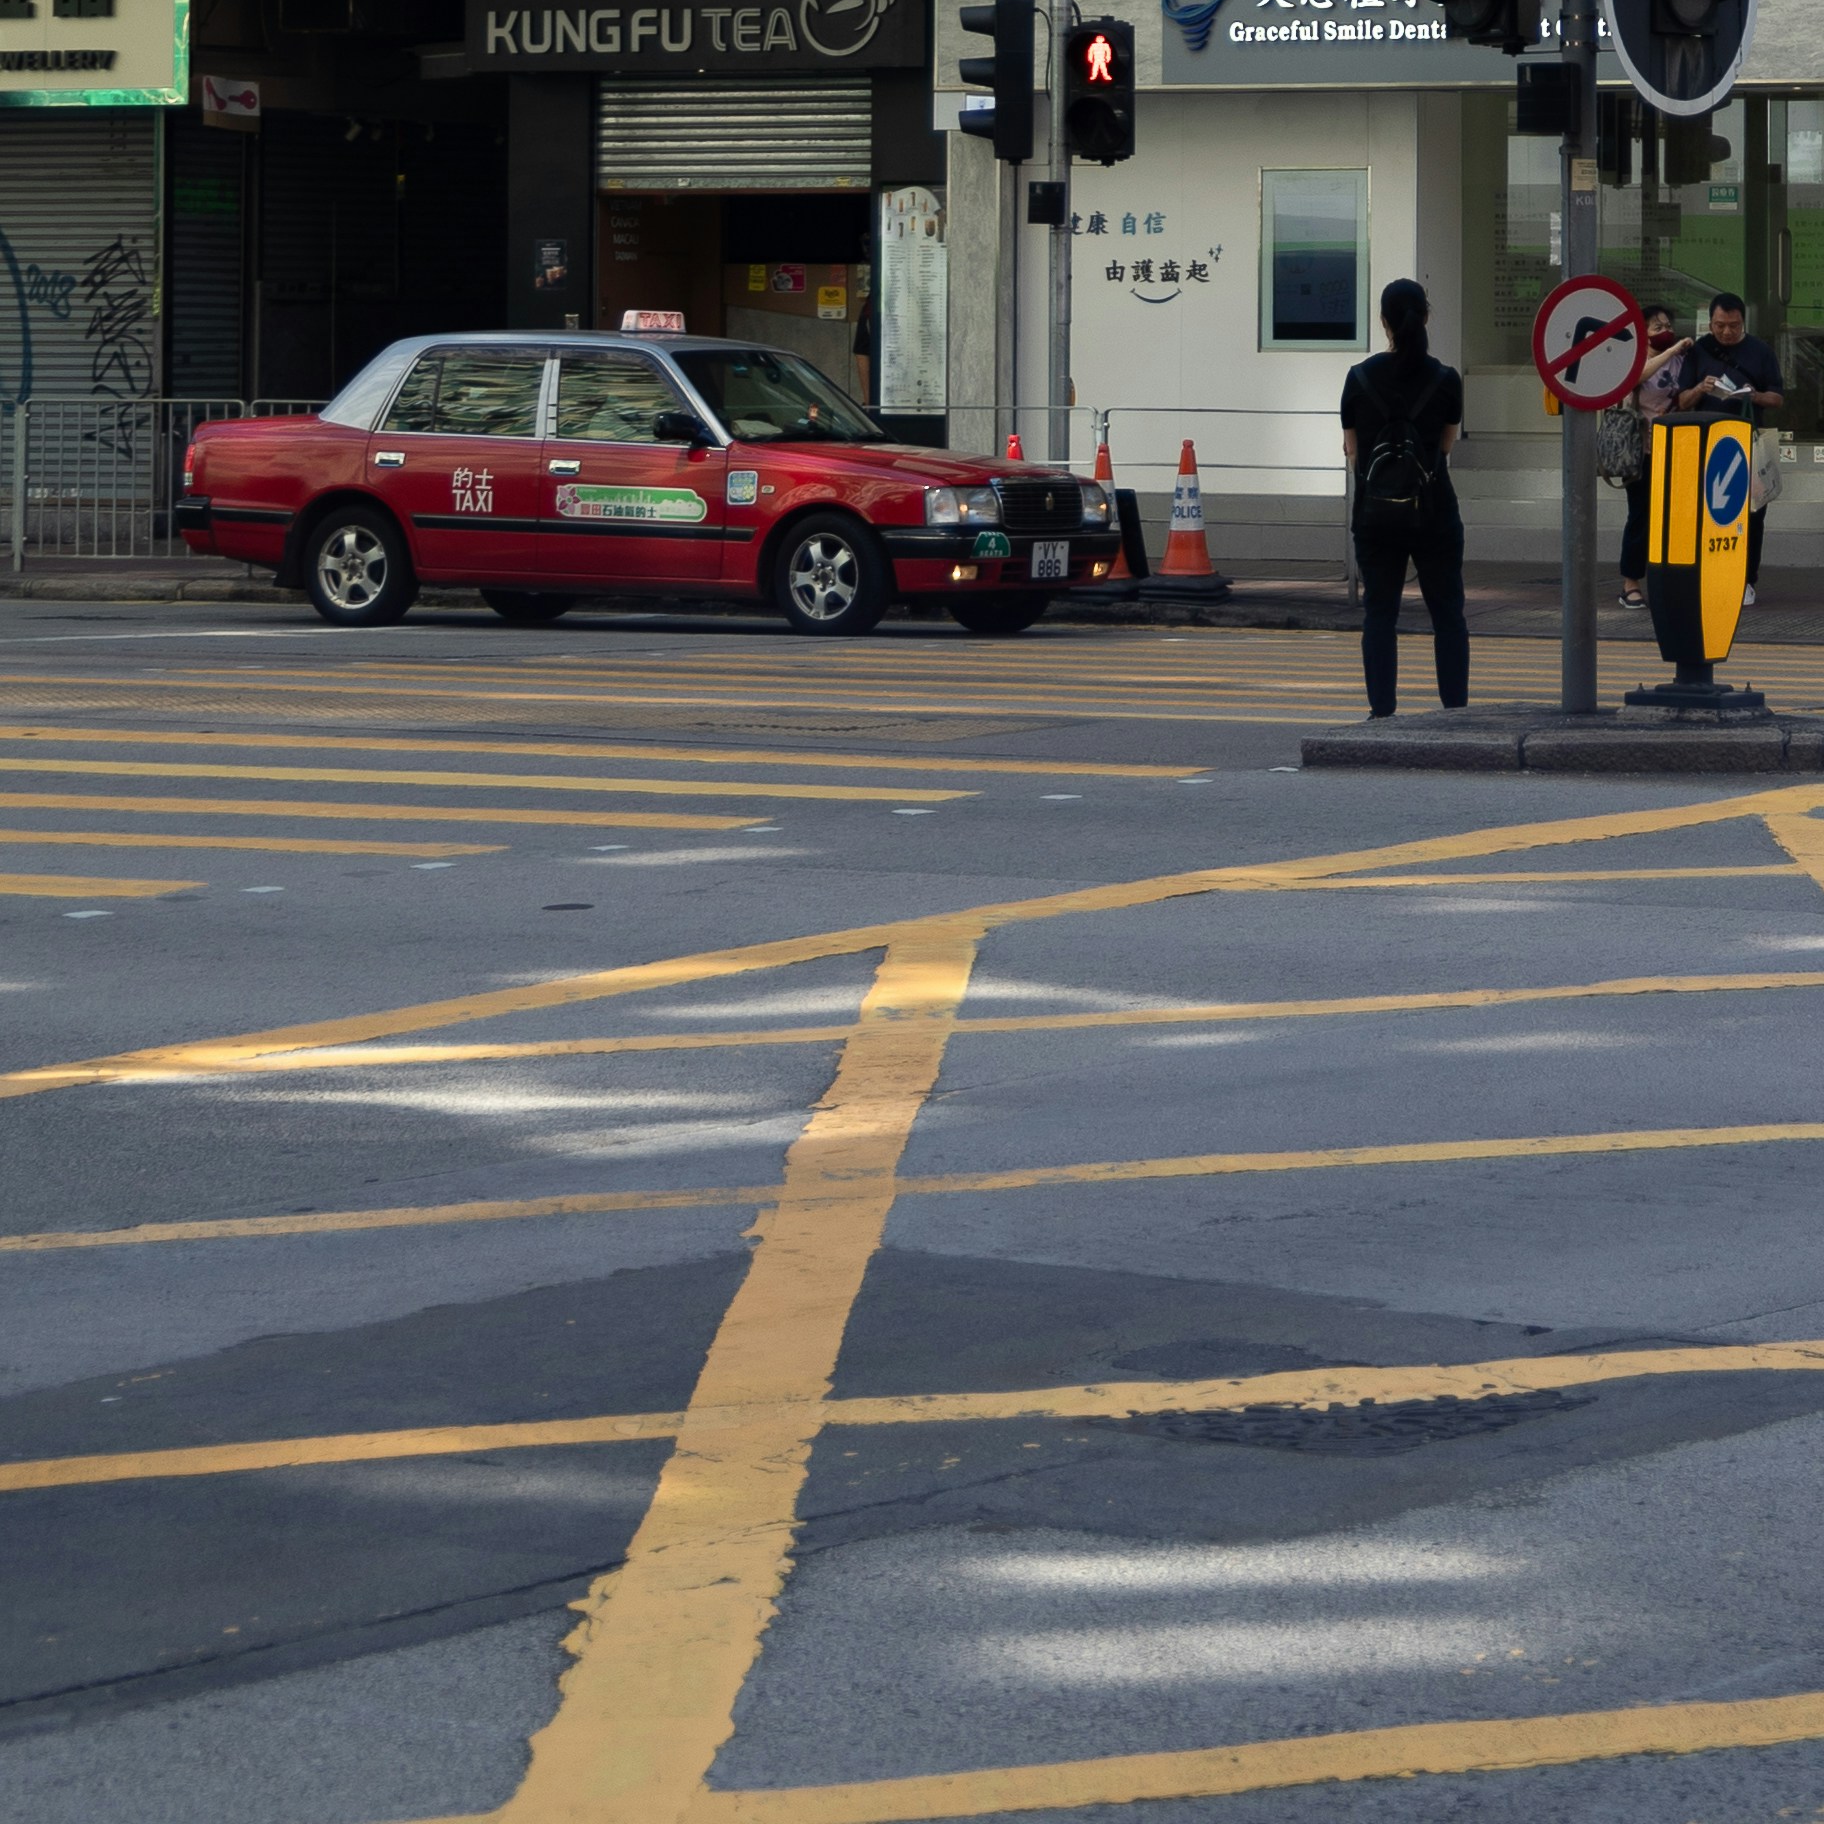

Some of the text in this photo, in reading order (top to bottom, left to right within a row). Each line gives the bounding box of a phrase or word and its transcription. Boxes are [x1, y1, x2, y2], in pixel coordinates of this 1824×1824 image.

[487, 7, 798, 54] KUNG FU TEA
[1229, 18, 1447, 43] Graceful Smile Denta
[1122, 211, 1167, 236] 自信
[1105, 258, 1210, 283] 由護齒起
[639, 312, 682, 329] TAXI
[452, 467, 494, 490] 的士
[452, 489, 493, 512] TAXI
[1171, 505, 1203, 519] POLICE
[987, 537, 996, 549] 4
[1043, 542, 1058, 560] VY
[1708, 536, 1738, 553] 3737
[1038, 559, 1061, 577] 886
